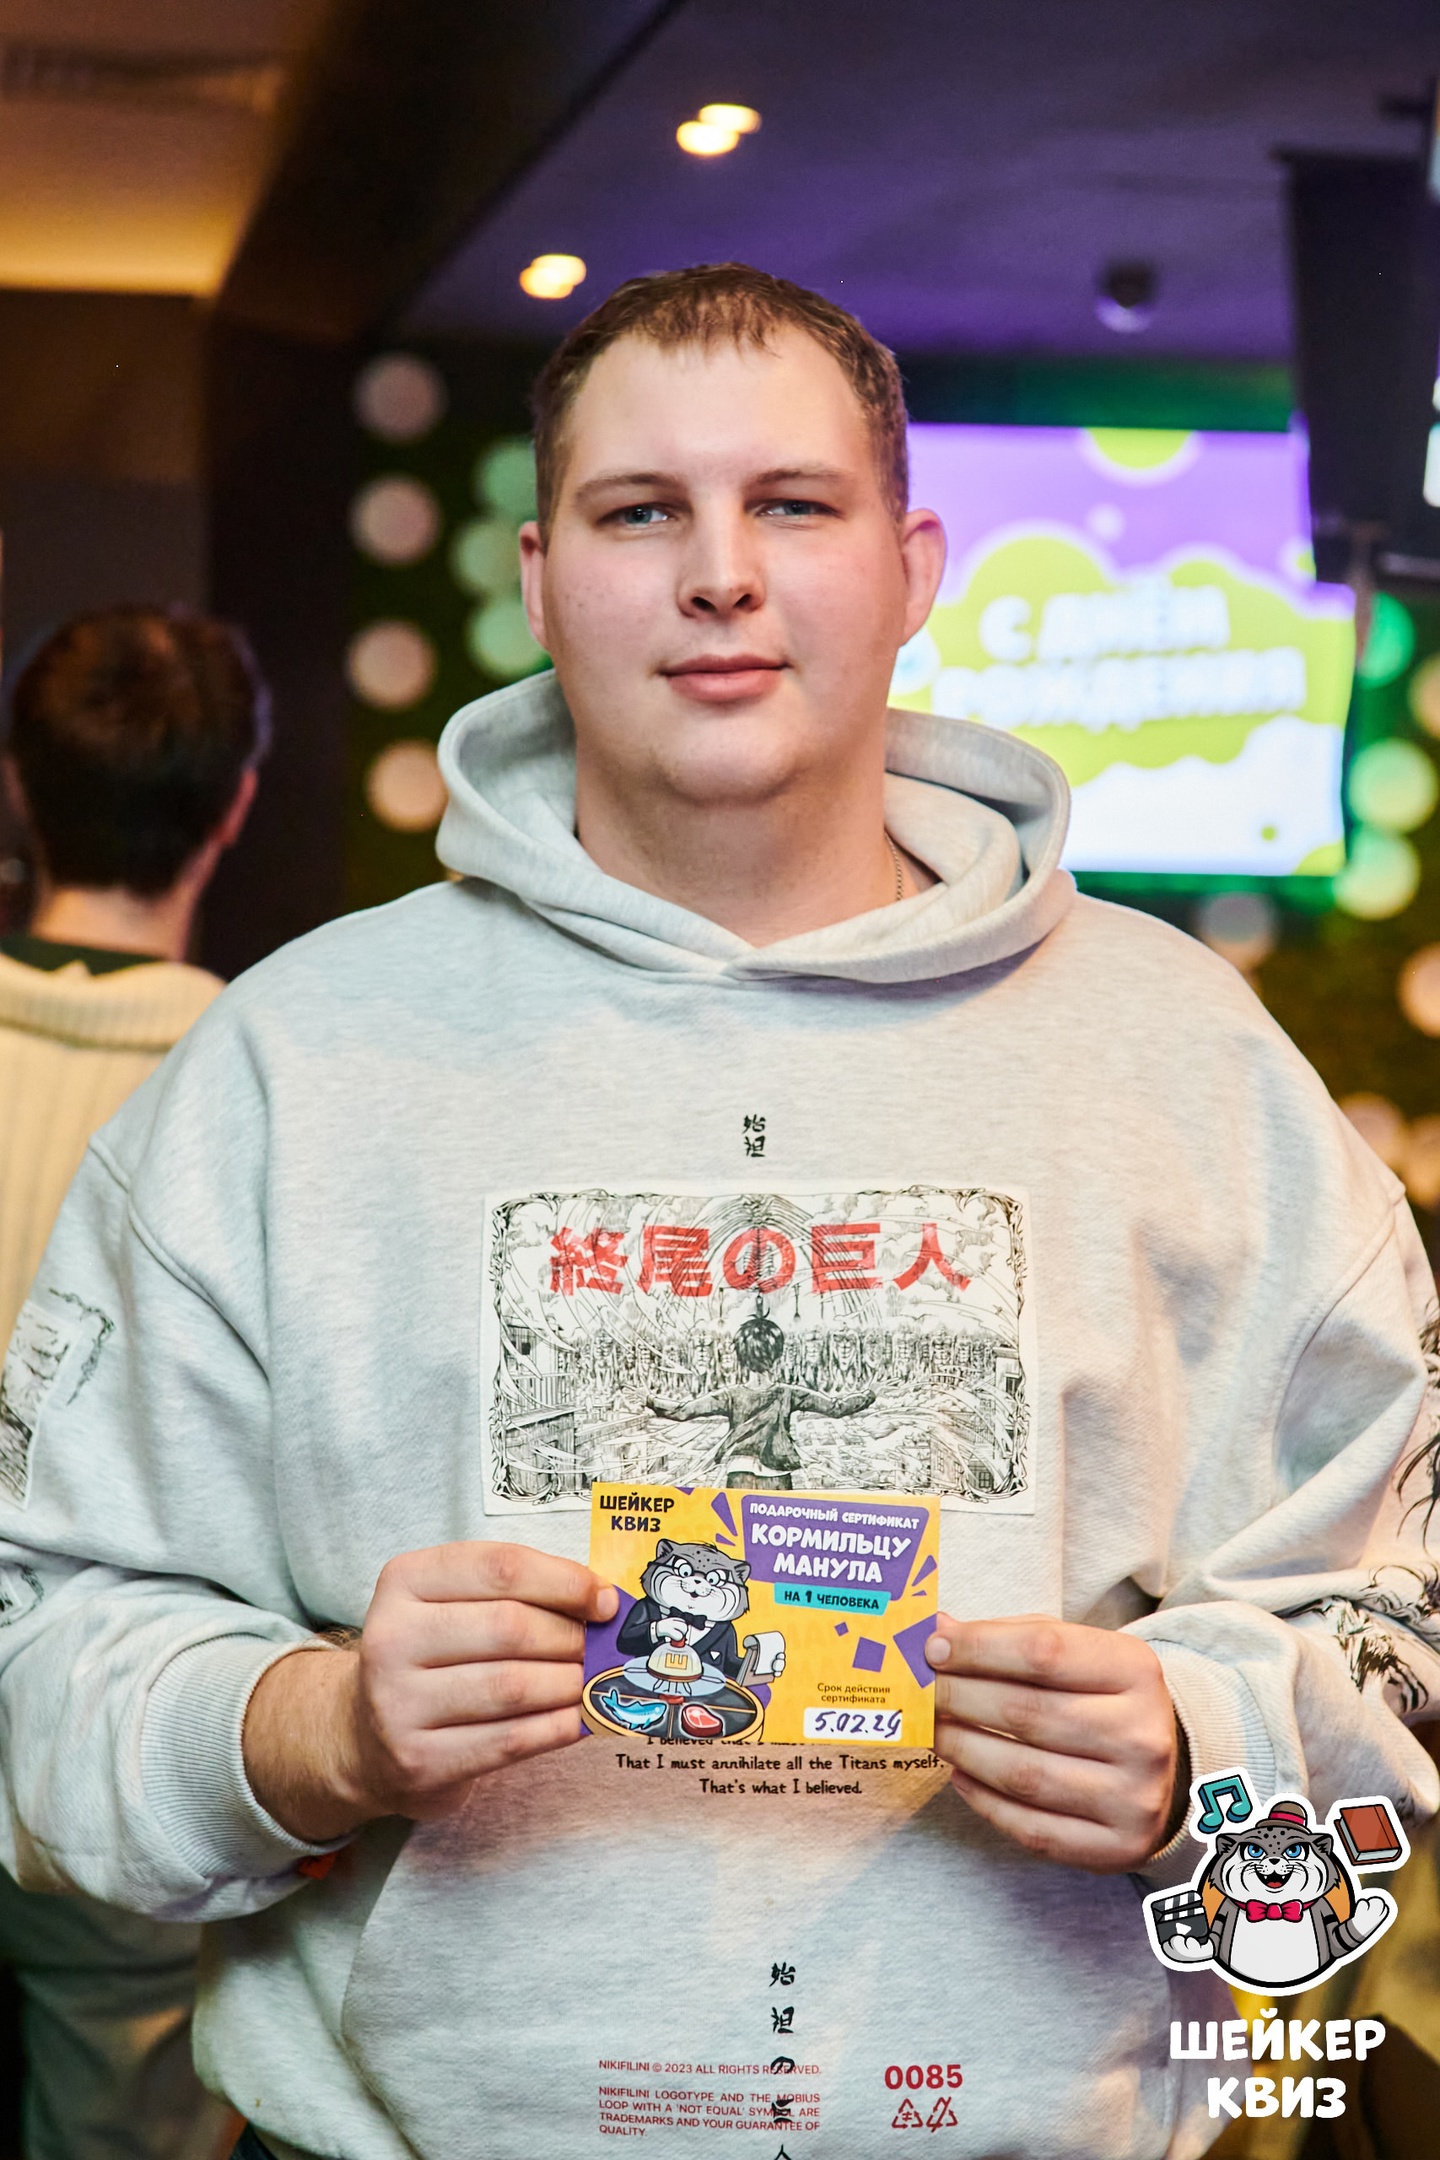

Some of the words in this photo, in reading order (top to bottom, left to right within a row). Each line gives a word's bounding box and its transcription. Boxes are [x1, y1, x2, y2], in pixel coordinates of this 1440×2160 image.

[549, 1222, 972, 1297] 終尾の巨人
[599, 1492, 675, 1513] ШЕЙКЕР
[611, 1515, 661, 1533] КВИЗ
[749, 1502, 838, 1522] ПОДАРОЧНЫЙ
[841, 1511, 919, 1530] СЕРТИФИКАТ
[751, 1522, 912, 1561] КОРМИЛЬЦУ
[773, 1552, 883, 1583] МАНУЛА
[784, 1590, 801, 1602] НА
[805, 1590, 813, 1604] 1
[816, 1593, 880, 1610] ЧЕЛОВЕКА
[665, 1652, 689, 1671] Ш
[817, 1682, 842, 1694] Срок
[844, 1684, 891, 1694] действия
[821, 1693, 886, 1704] сертификата
[615, 1753, 651, 1769] That
[656, 1753, 664, 1769] I
[670, 1757, 706, 1769] must
[711, 1755, 782, 1770] annihilate
[786, 1755, 803, 1770] all
[809, 1756, 833, 1770] the
[839, 1754, 887, 1770] Titans
[893, 1754, 945, 1772] myself.
[699, 1778, 746, 1794] That's
[752, 1780, 787, 1794] what
[793, 1778, 800, 1794] I
[806, 1779, 863, 1795] believed.
[598, 2060, 650, 2072] NIKIFILINI
[664, 2063, 693, 2073] 2023
[695, 2064, 716, 2074] ALL
[718, 2064, 760, 2075] RIGHTS
[884, 2063, 963, 2090] 0085
[598, 2086, 650, 2099] NIKIFILINI
[655, 2090, 714, 2102] LOGOTYPE
[720, 2093, 744, 2103] AND
[750, 2093, 771, 2103] THE
[776, 2093, 820, 2103] MOBIUS
[599, 2099, 629, 2110] LOOP
[632, 2101, 661, 2112] WITH
[665, 2103, 673, 2113] A
[749, 2107, 794, 2117] SYML
[799, 2107, 820, 2117] ARE
[600, 2112, 674, 2126] TRADEMARKS
[676, 2117, 700, 2128] AND
[703, 2118, 733, 2129] YOUR
[735, 2120, 802, 2131] GUARANTEE
[805, 2121, 820, 2131] OF
